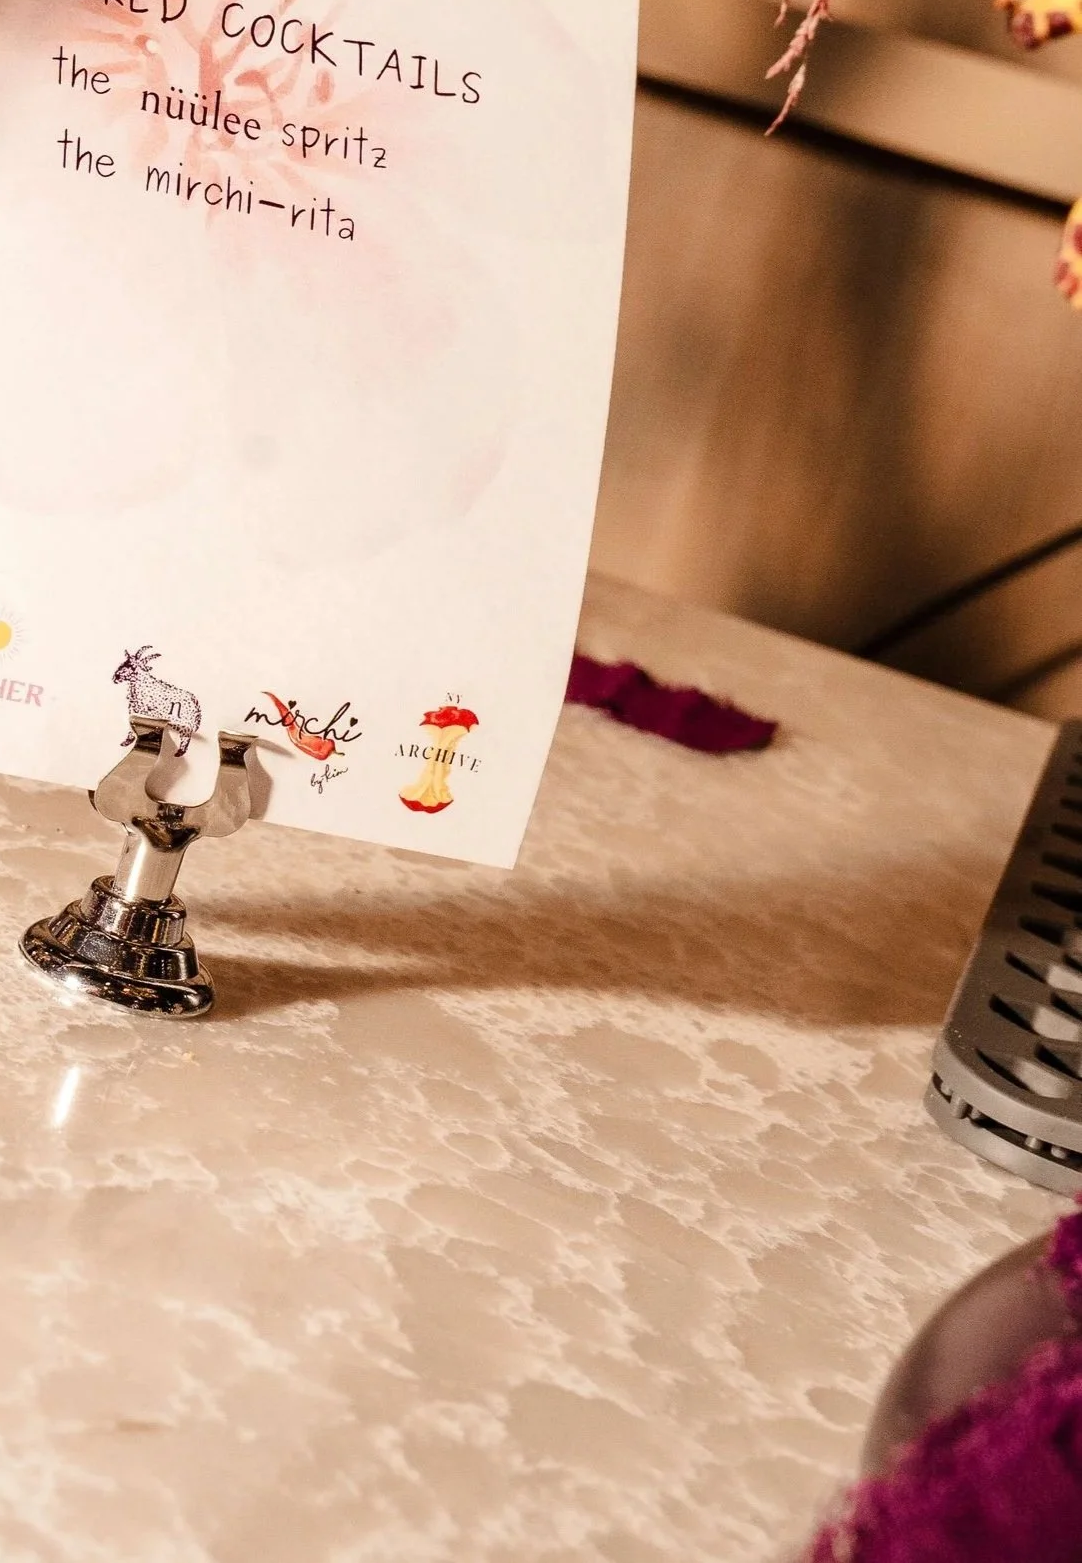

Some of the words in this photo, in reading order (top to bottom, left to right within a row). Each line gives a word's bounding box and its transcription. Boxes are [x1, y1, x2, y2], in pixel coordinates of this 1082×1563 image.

[220, 2, 483, 104] COCKTAILS
[51, 45, 112, 94] the
[140, 86, 262, 141] nüülee
[281, 121, 388, 170] spritz
[57, 128, 116, 179] the
[244, 700, 364, 744] mirchi
[394, 743, 483, 774] ARCHIVE
